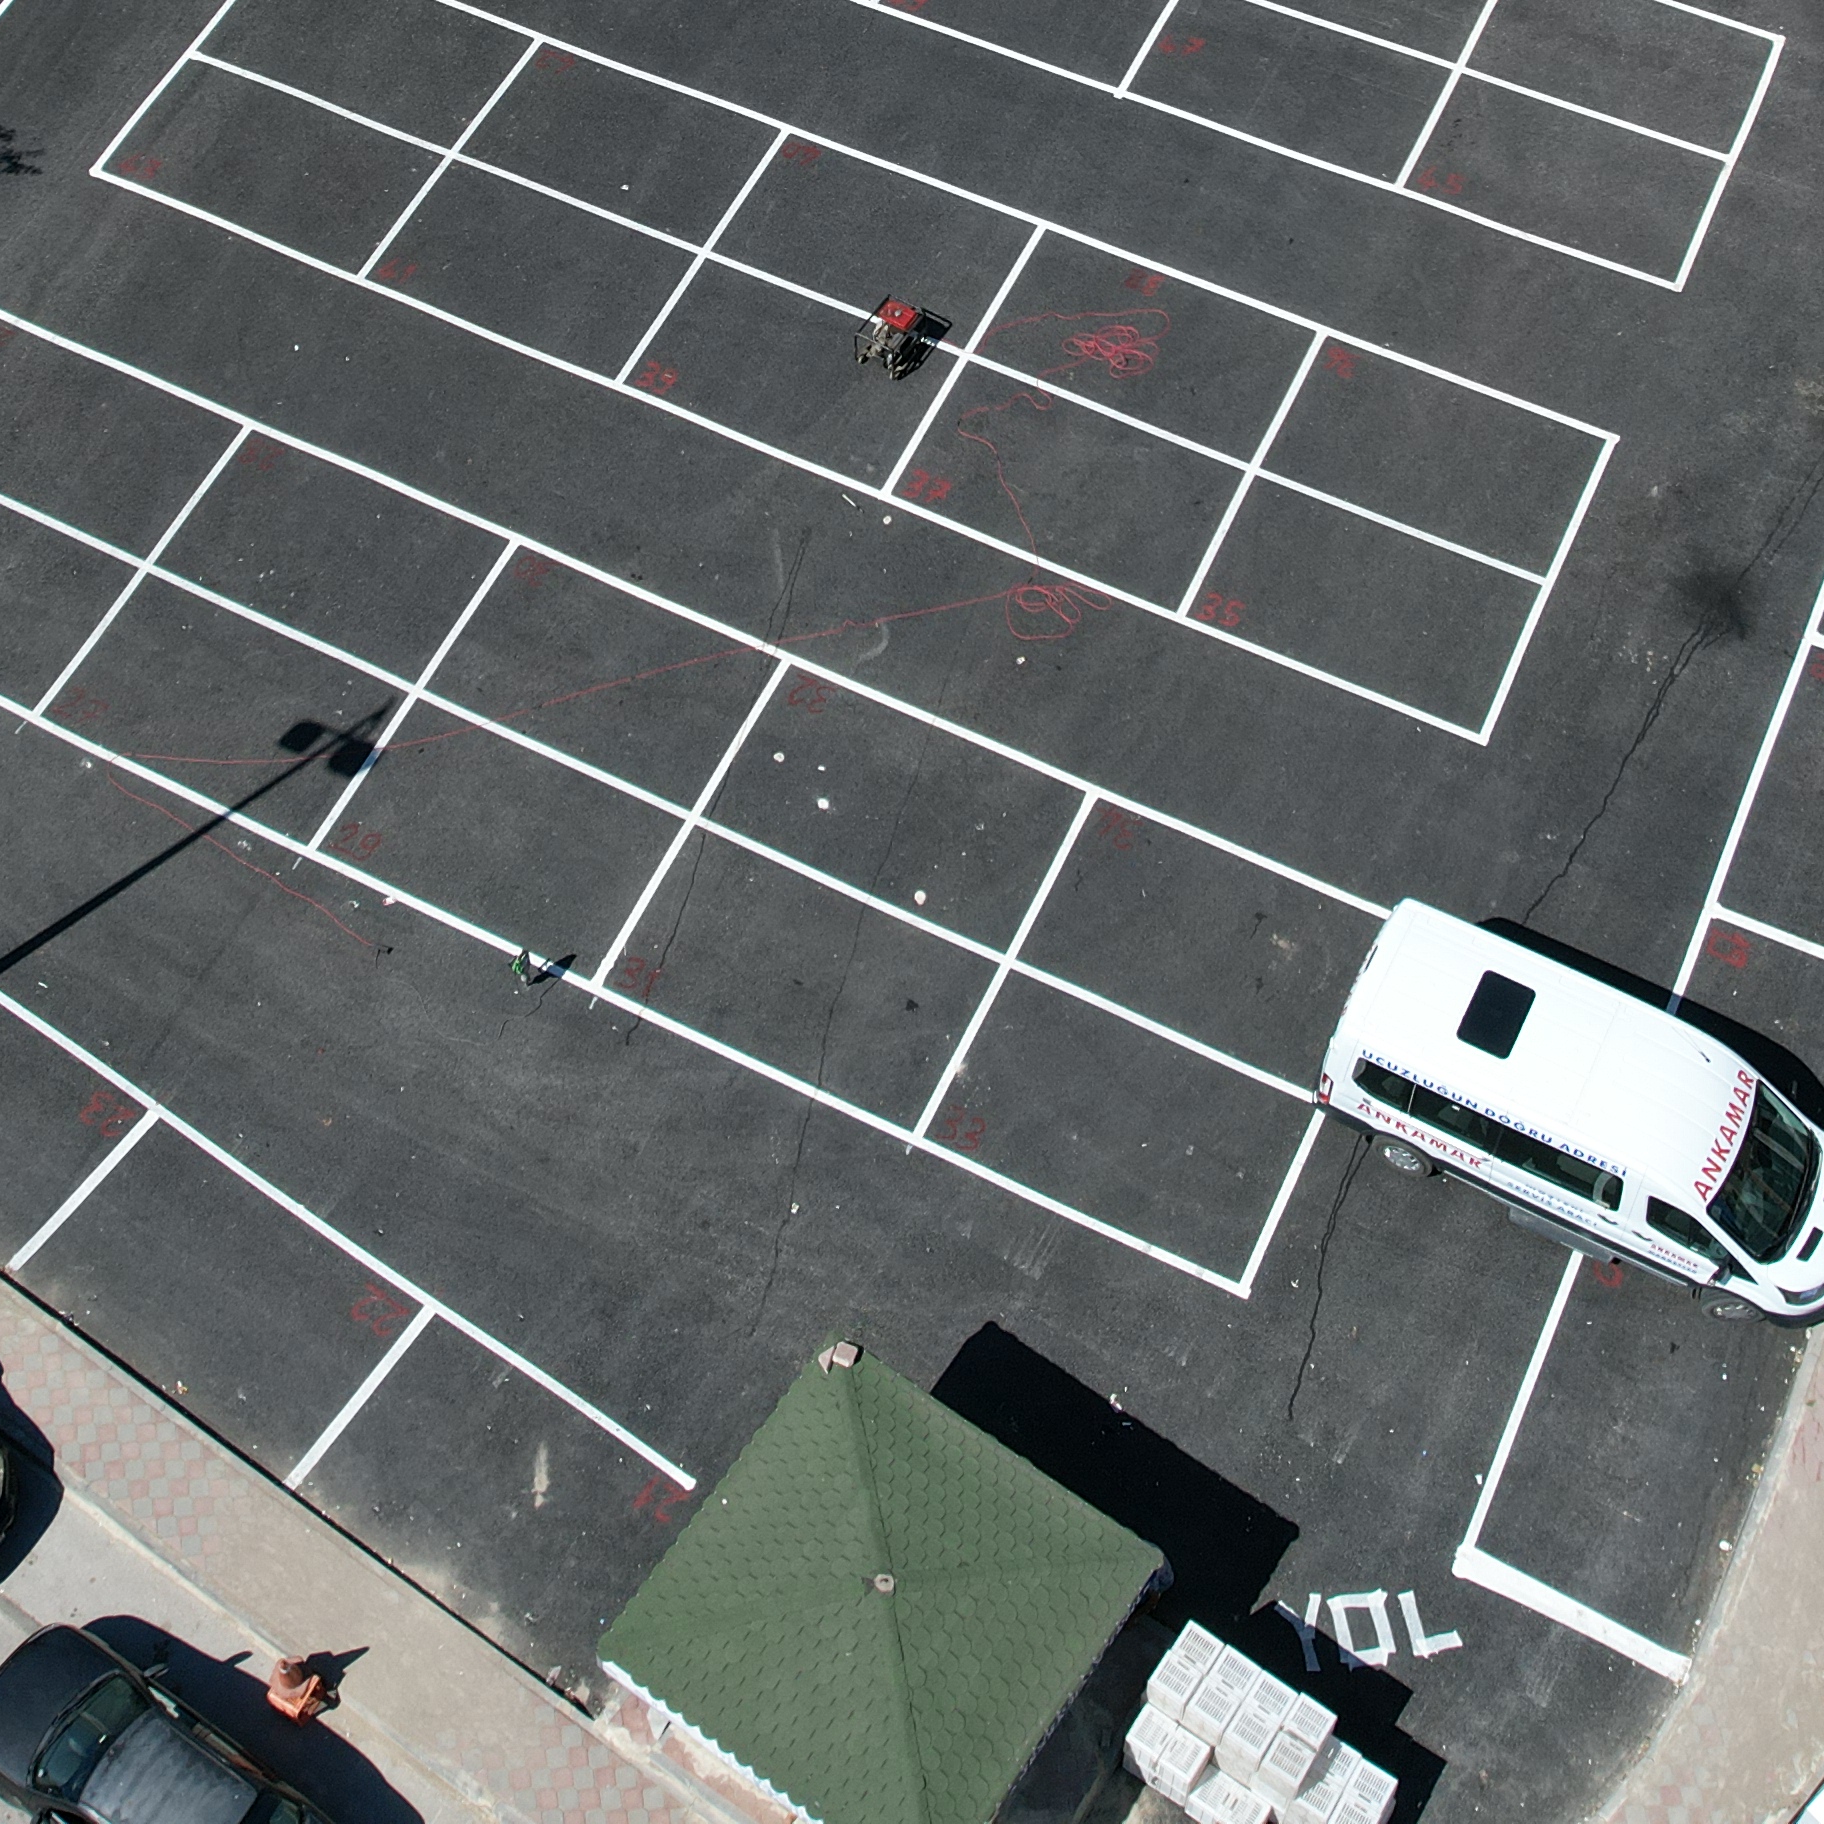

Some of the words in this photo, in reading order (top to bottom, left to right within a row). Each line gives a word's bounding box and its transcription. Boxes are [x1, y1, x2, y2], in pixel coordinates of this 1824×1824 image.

[1195, 592, 1247, 627] 35
[80, 1091, 136, 1138] 23
[1693, 1069, 1755, 1202] ANKAMAR
[351, 1282, 413, 1337] 22
[1274, 1587, 1463, 1673] YOL
